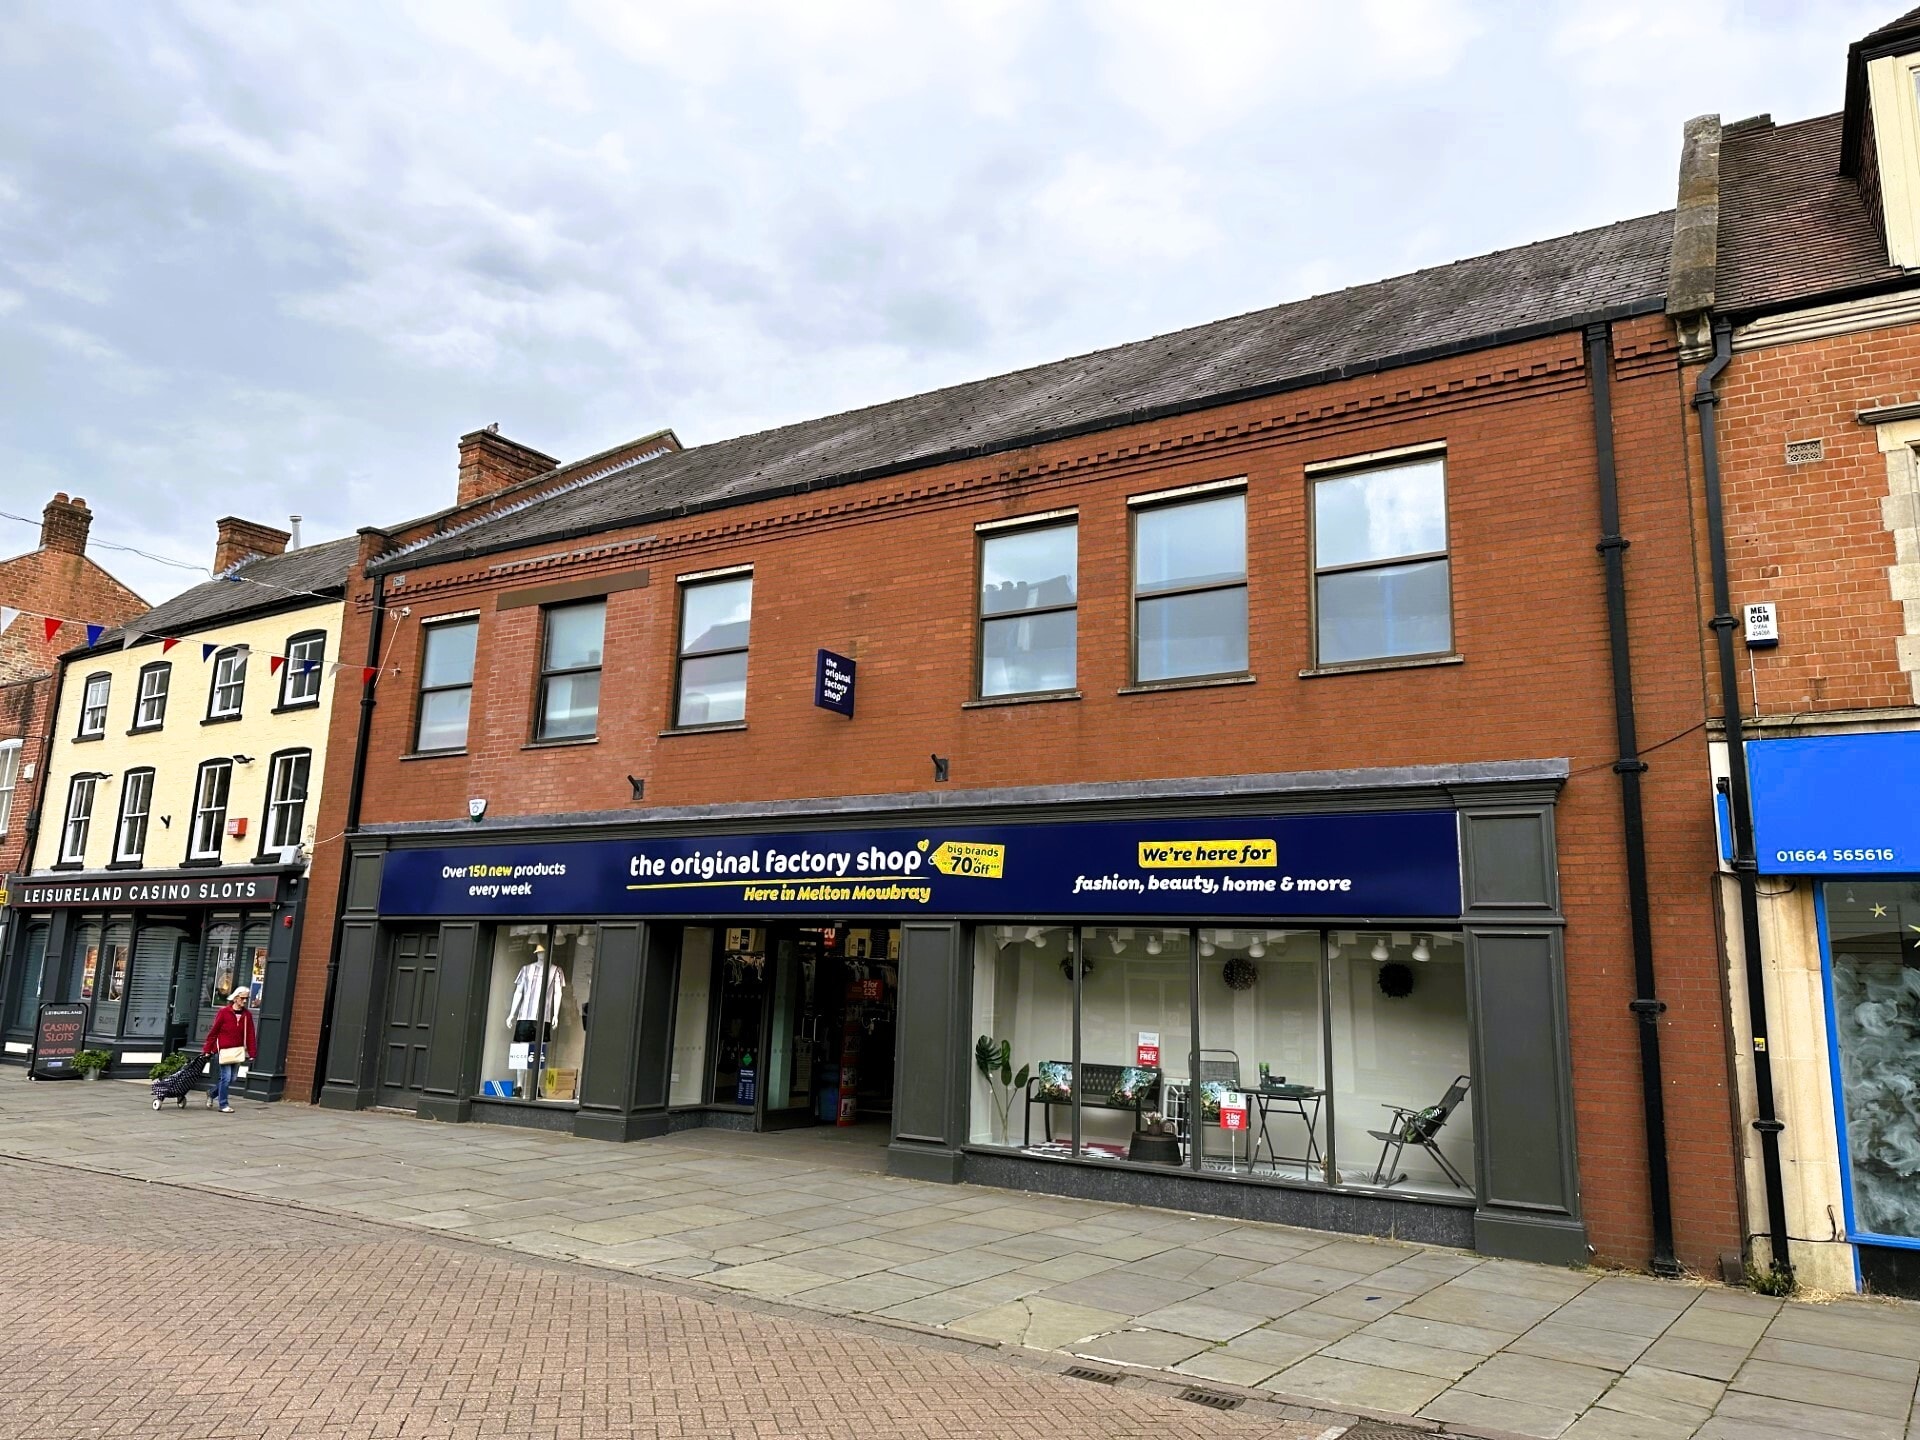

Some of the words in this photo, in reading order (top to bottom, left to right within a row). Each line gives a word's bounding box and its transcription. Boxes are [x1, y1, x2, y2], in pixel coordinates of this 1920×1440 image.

[1750, 606, 1768, 614] MEL
[1750, 614, 1770, 624] COM
[826, 658, 838, 668] the
[825, 669, 851, 683] original
[824, 678, 848, 694] factory
[824, 689, 841, 701] shop
[947, 845, 963, 855] big
[965, 846, 999, 857] brands
[1143, 847, 1193, 862] We're
[1195, 846, 1238, 861] here
[1239, 845, 1272, 864] for
[1776, 850, 1827, 862] 01664
[1833, 848, 1894, 861] 565616
[630, 854, 666, 877] the
[670, 850, 760, 880] original
[765, 849, 851, 877] factory
[856, 846, 922, 875] shop
[973, 864, 990, 875] off
[442, 866, 468, 878] Over
[468, 865, 488, 878] 150
[488, 866, 513, 877] new
[514, 862, 567, 879] products
[468, 884, 500, 898] every
[501, 882, 532, 896] week
[1072, 873, 1145, 894] fashion,
[1147, 874, 1219, 894] beauty,
[1222, 876, 1277, 892] home
[1280, 876, 1294, 891] &
[1296, 878, 1352, 892] more
[23, 886, 123, 903] LEISURELAND
[128, 883, 191, 900] CASINO
[198, 881, 257, 898] SLOTS
[743, 887, 780, 901] Here
[781, 883, 796, 901] in
[797, 885, 851, 901] Melton
[851, 884, 931, 904] Mowbray
[42, 1023, 80, 1032] CASINO
[45, 1032, 74, 1042] SLOTS
